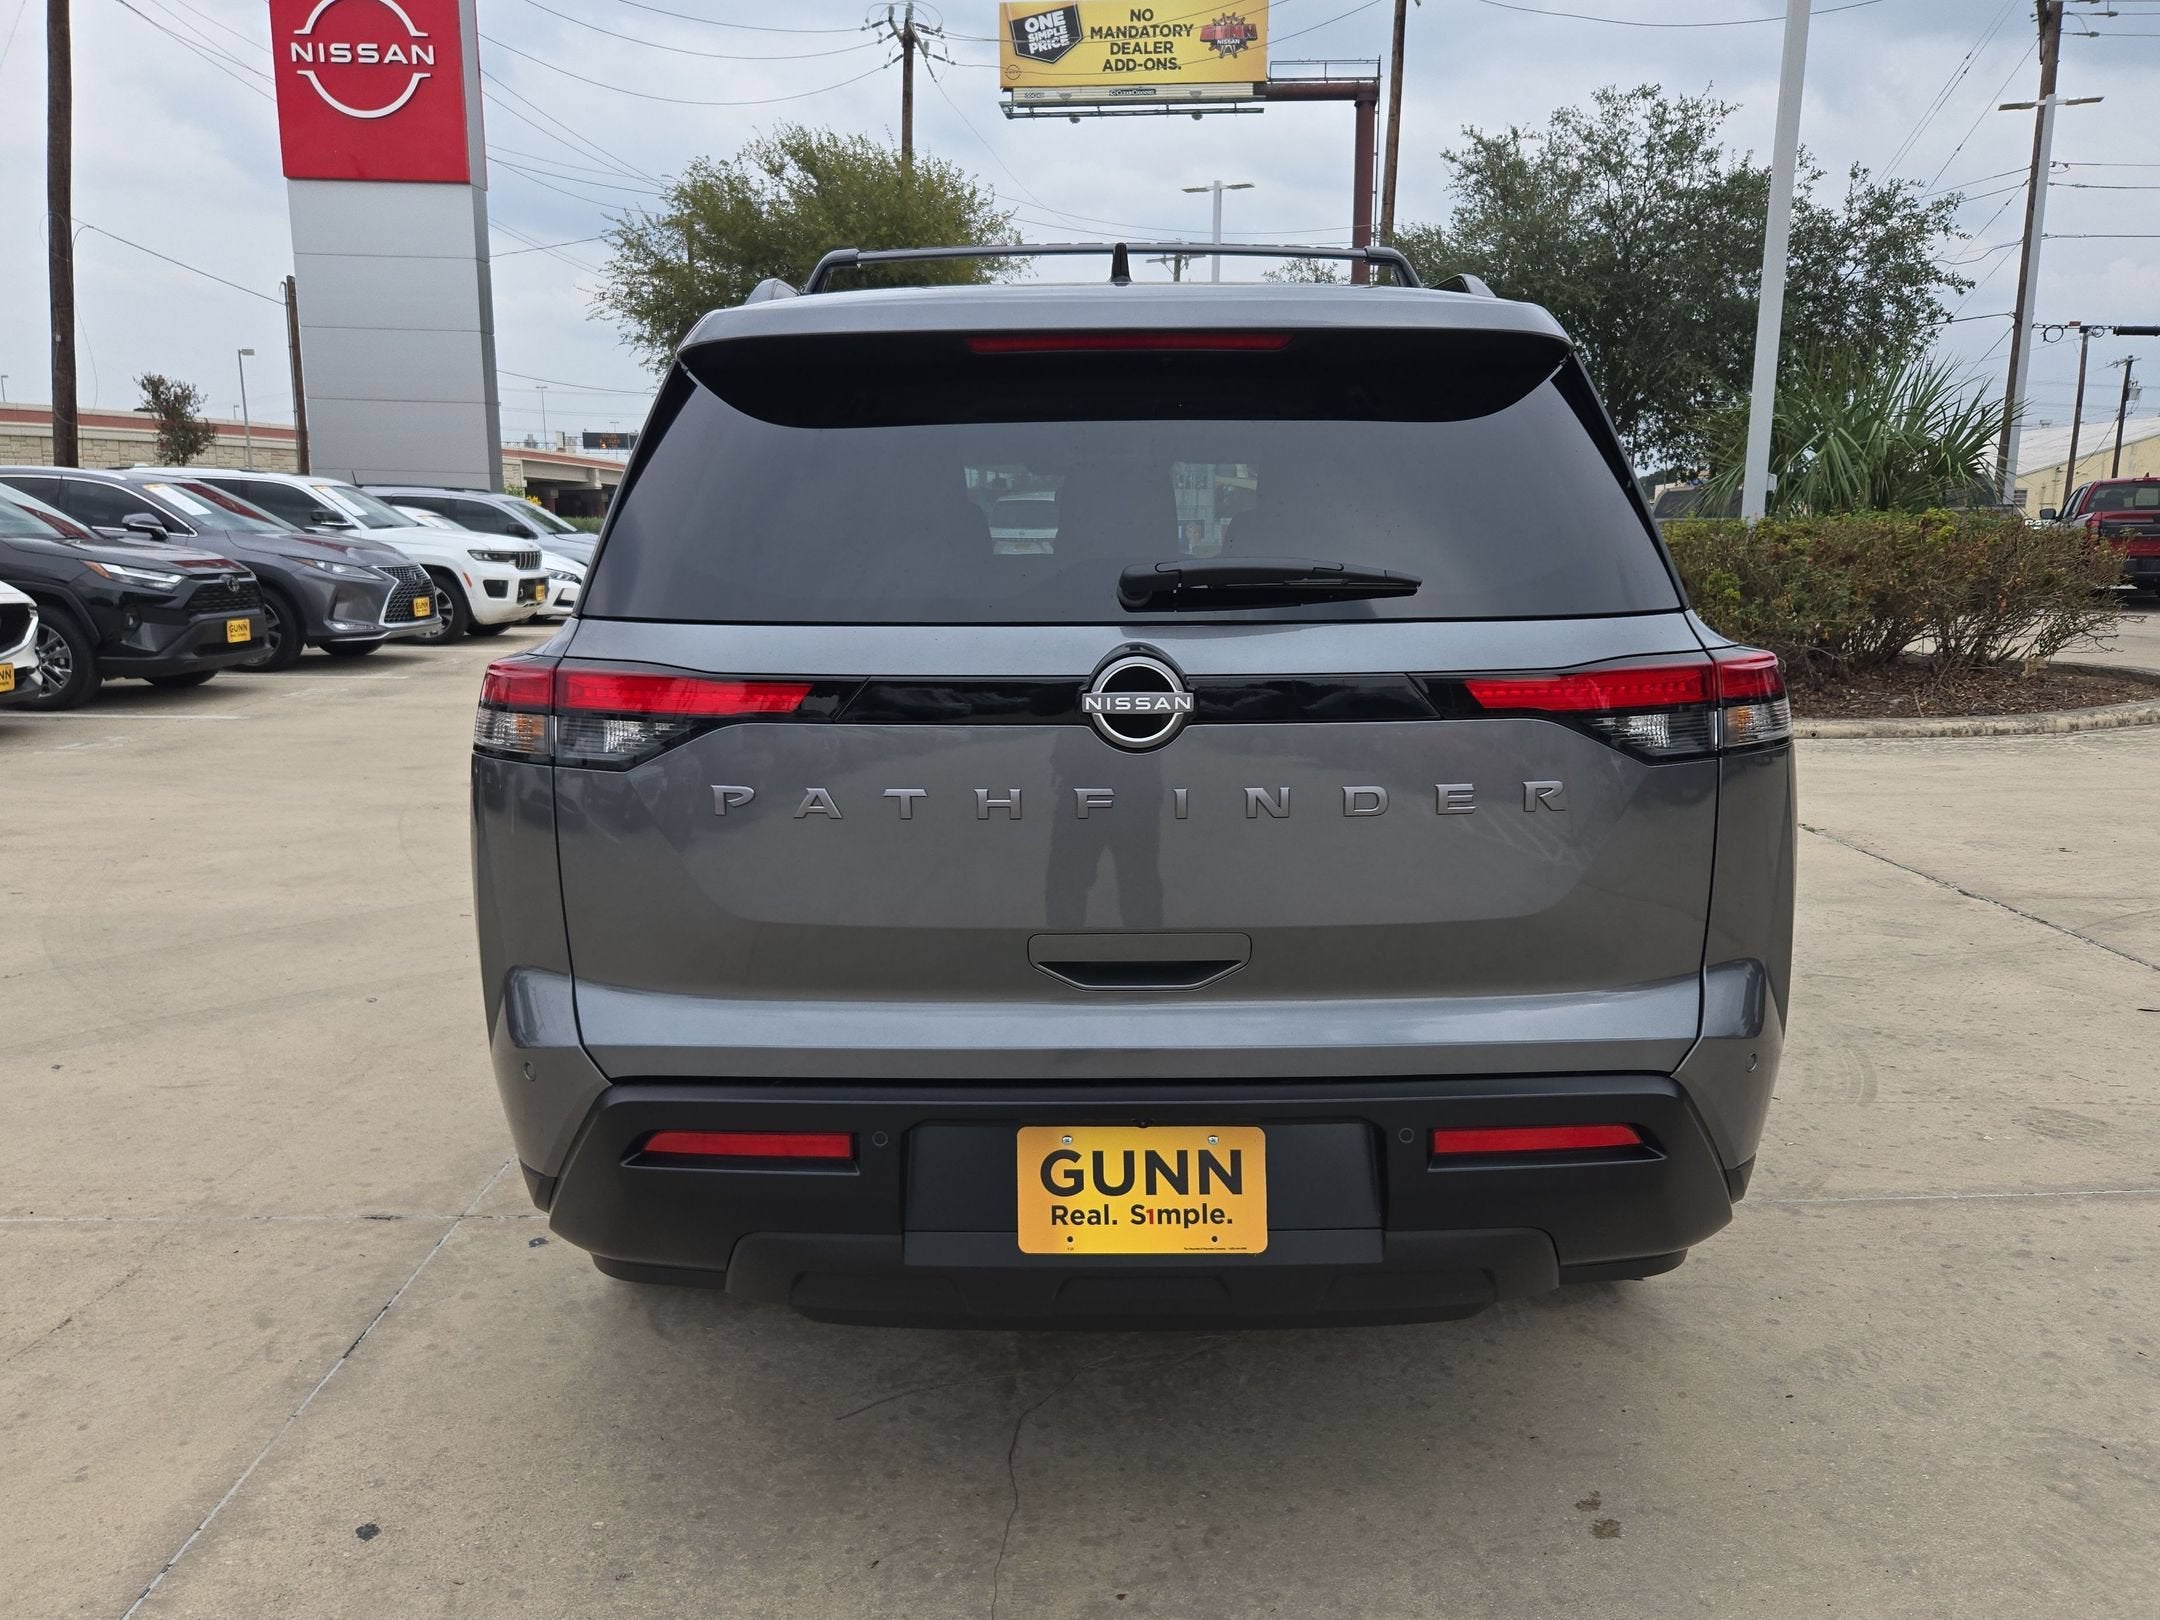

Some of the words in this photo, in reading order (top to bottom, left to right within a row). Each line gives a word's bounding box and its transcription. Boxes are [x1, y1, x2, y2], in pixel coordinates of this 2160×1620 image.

[1024, 10, 1066, 33] ONE
[1130, 8, 1154, 22] NO
[1027, 25, 1068, 43] SIMPLE
[1090, 24, 1194, 40] MANDATORY
[290, 42, 435, 65] NISSAN
[1028, 34, 1070, 54] PRICE
[1110, 41, 1174, 55] DEALER
[1102, 57, 1182, 72] ADD-ONS.
[1085, 696, 1191, 710] NISSAN
[710, 779, 1567, 820] PATHFINDER
[1040, 1149, 1243, 1197] GUNN
[1051, 1204, 1118, 1226] Real.
